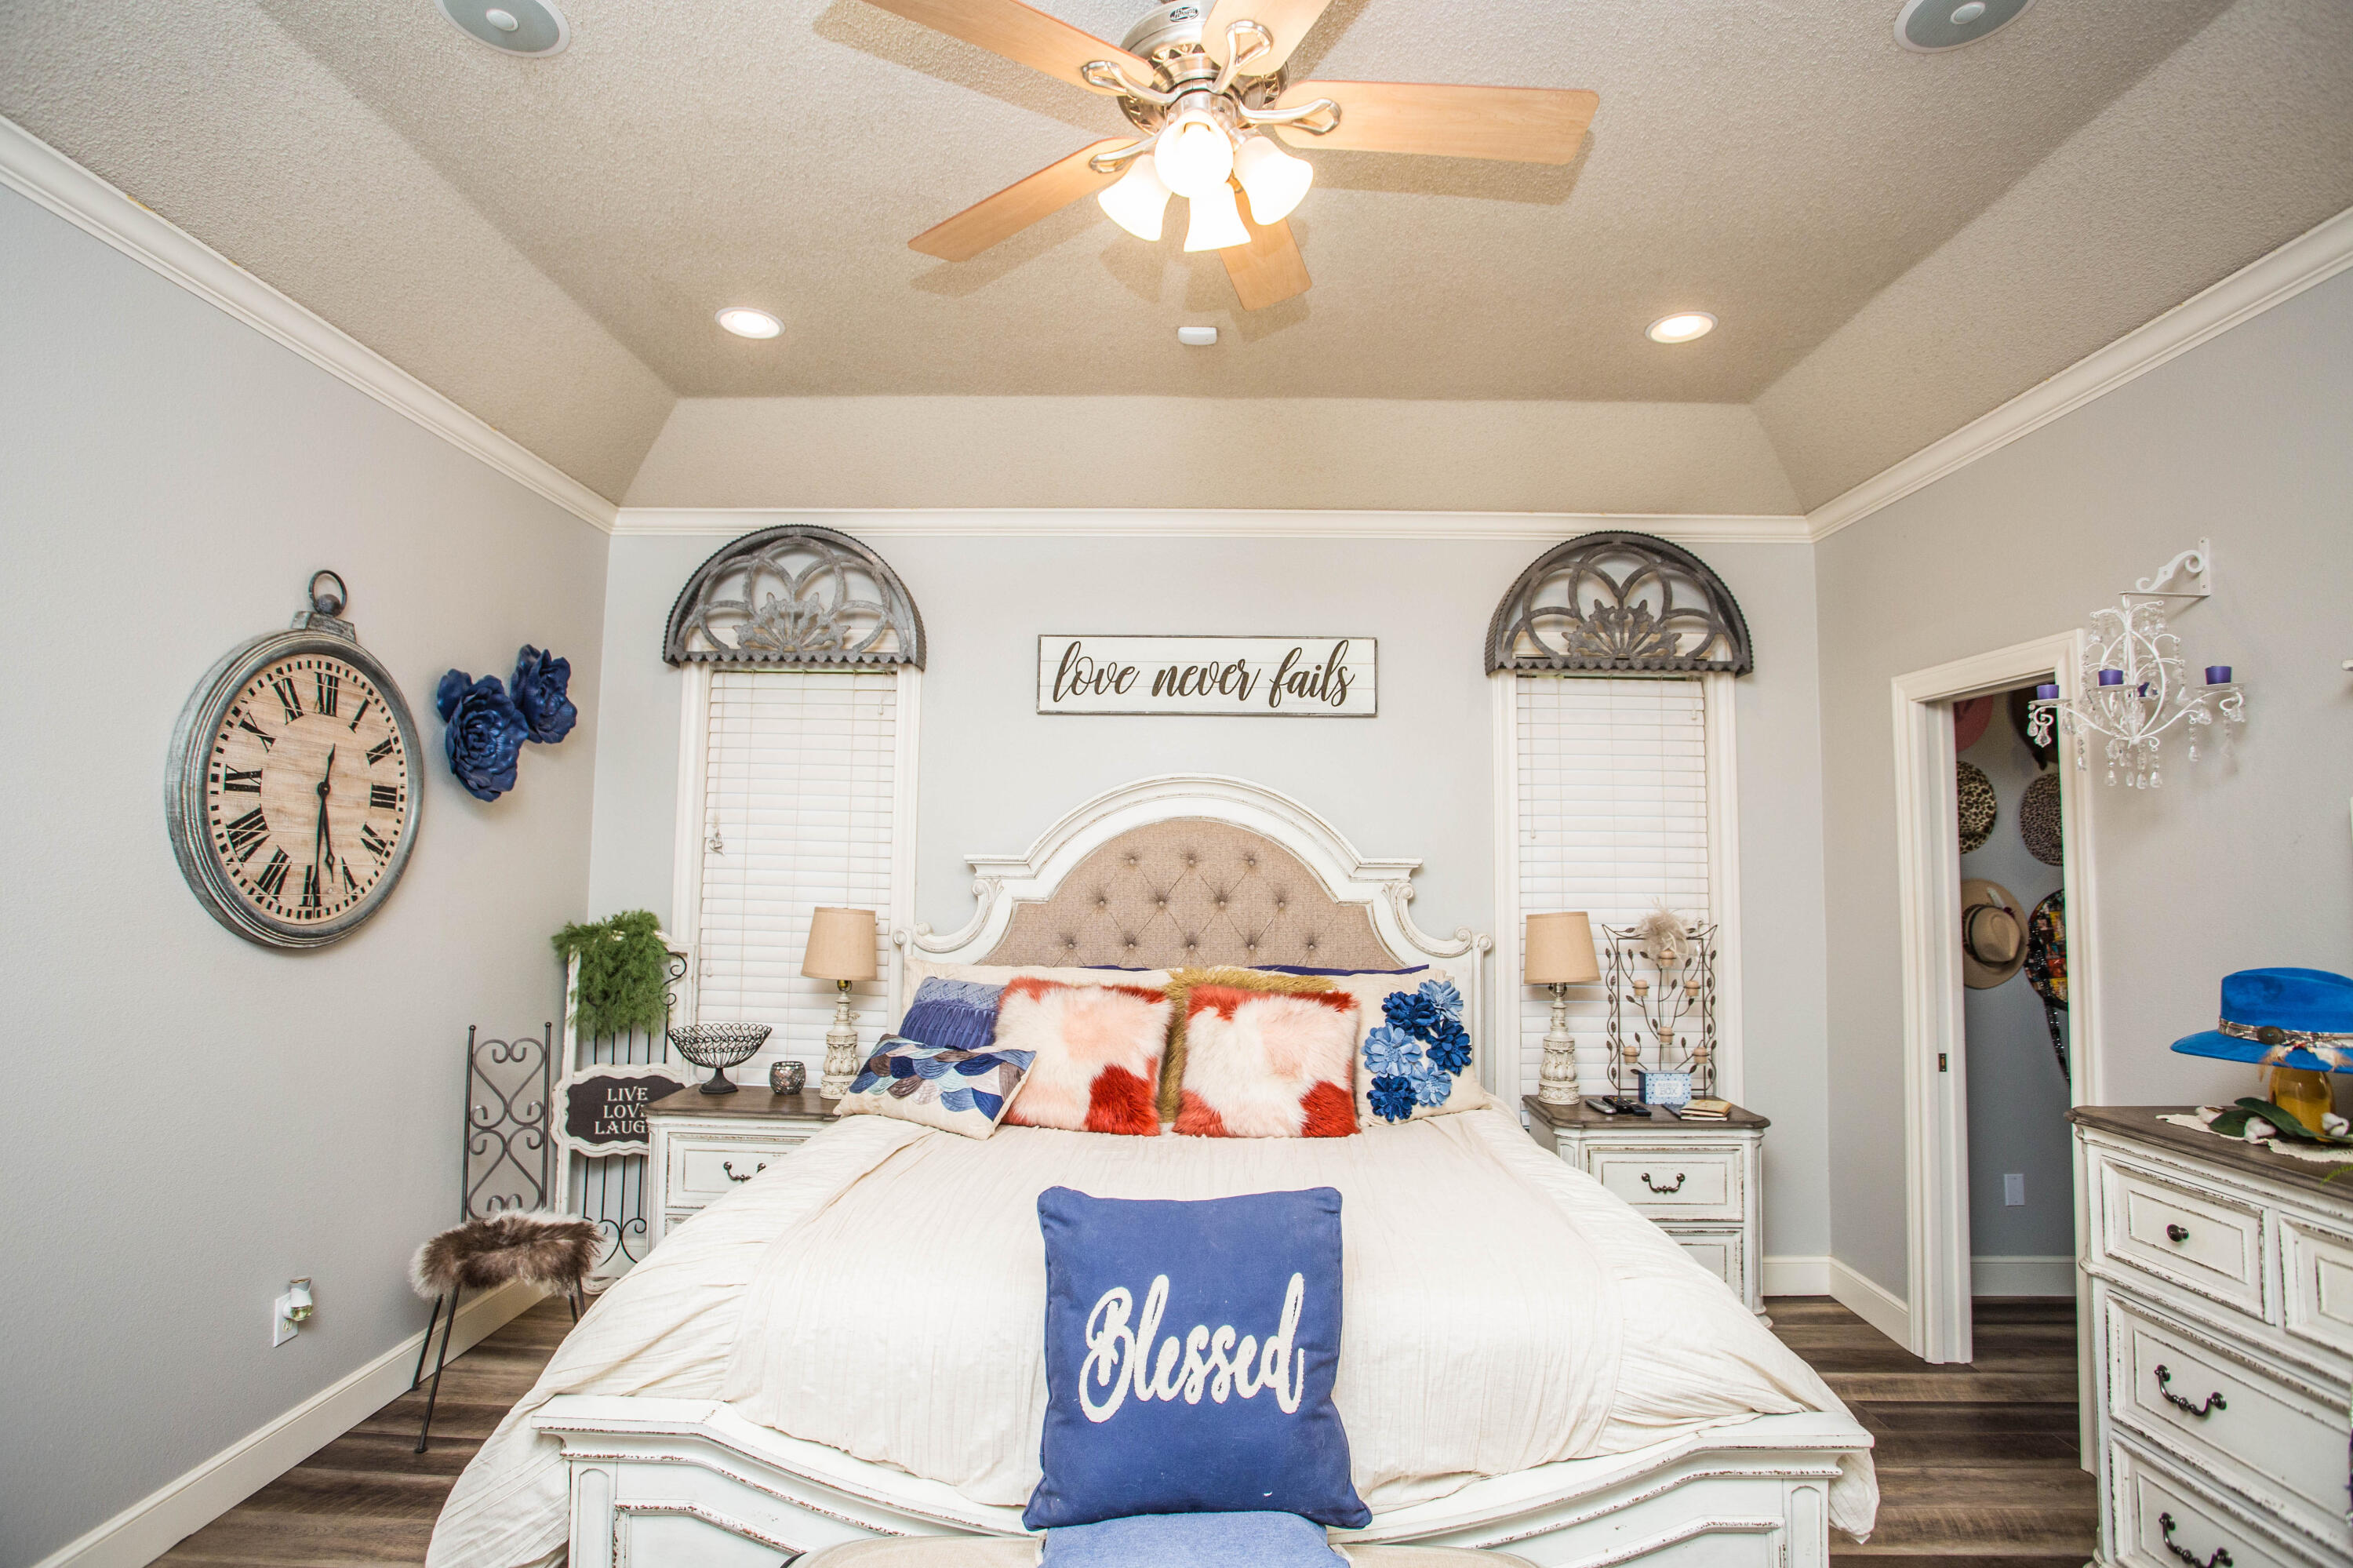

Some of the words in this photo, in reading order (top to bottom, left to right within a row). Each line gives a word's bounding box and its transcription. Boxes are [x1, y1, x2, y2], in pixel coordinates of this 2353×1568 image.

[1053, 641, 1140, 703] love
[1151, 658, 1260, 701] never
[1268, 639, 1355, 708] fails
[271, 677, 307, 726] XI
[315, 671, 341, 718] XII
[238, 709, 276, 753] X
[348, 697, 371, 733] I
[365, 735, 394, 768] II
[223, 763, 263, 797] IX
[369, 782, 398, 810] III
[341, 856, 359, 895] V
[607, 1086, 649, 1101] LIVE
[595, 1121, 649, 1134] LAUG
[1078, 1272, 1305, 1423] Blessed
